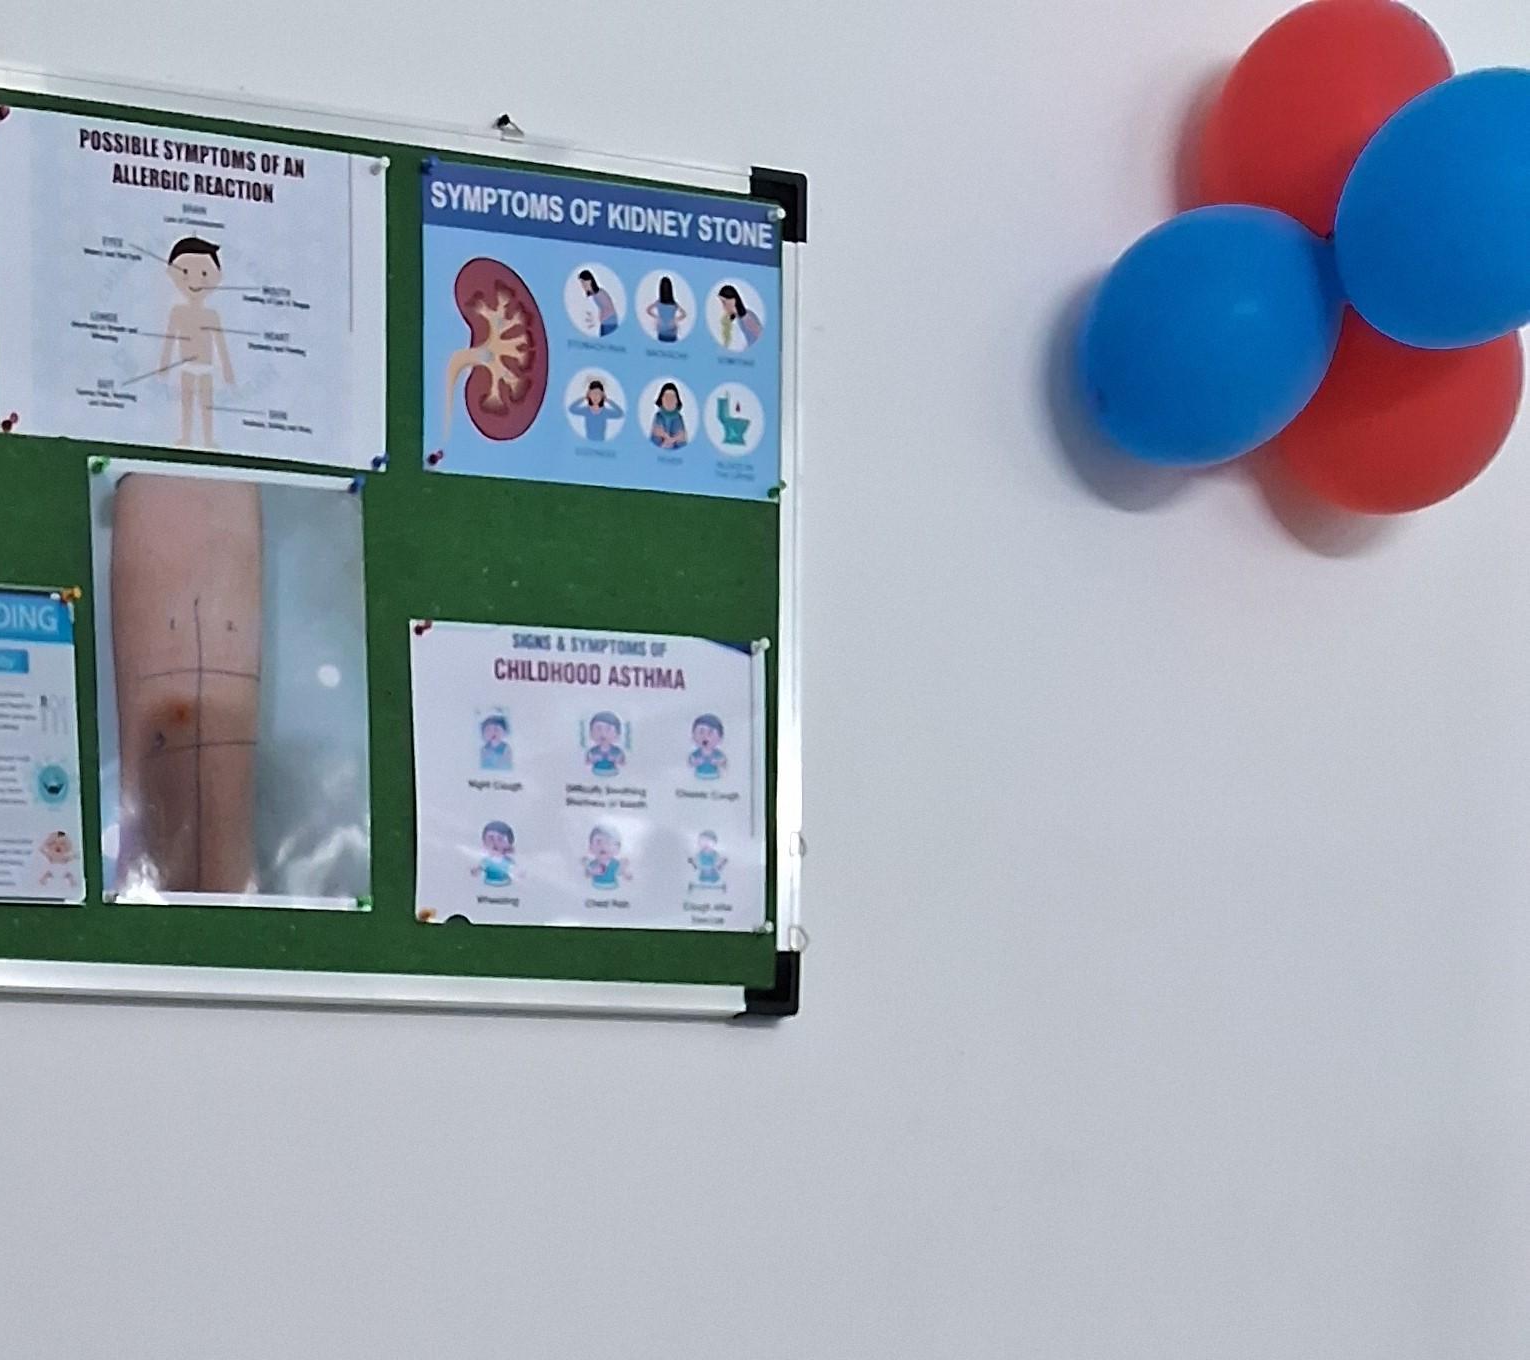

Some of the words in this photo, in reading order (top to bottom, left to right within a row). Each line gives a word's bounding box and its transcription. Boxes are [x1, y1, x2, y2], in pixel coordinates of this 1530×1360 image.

[79, 128, 159, 157] POSSIBLE
[163, 141, 256, 173] SYMPTOMS
[261, 153, 280, 175] OF
[283, 156, 305, 178] AN
[112, 163, 190, 193] ALLERGIC
[193, 173, 274, 203] REACTION
[430, 180, 563, 223] SYMPTOMS
[570, 199, 601, 226] OF
[608, 203, 692, 238] KIDNEY
[698, 215, 773, 249] STONE
[512, 633, 551, 651] SIGNS
[556, 635, 565, 652] &
[571, 636, 647, 658] SYMPTOMS
[651, 641, 667, 658] OF
[494, 657, 601, 686] CHILDHOOD
[608, 665, 686, 690] ASTHMA
